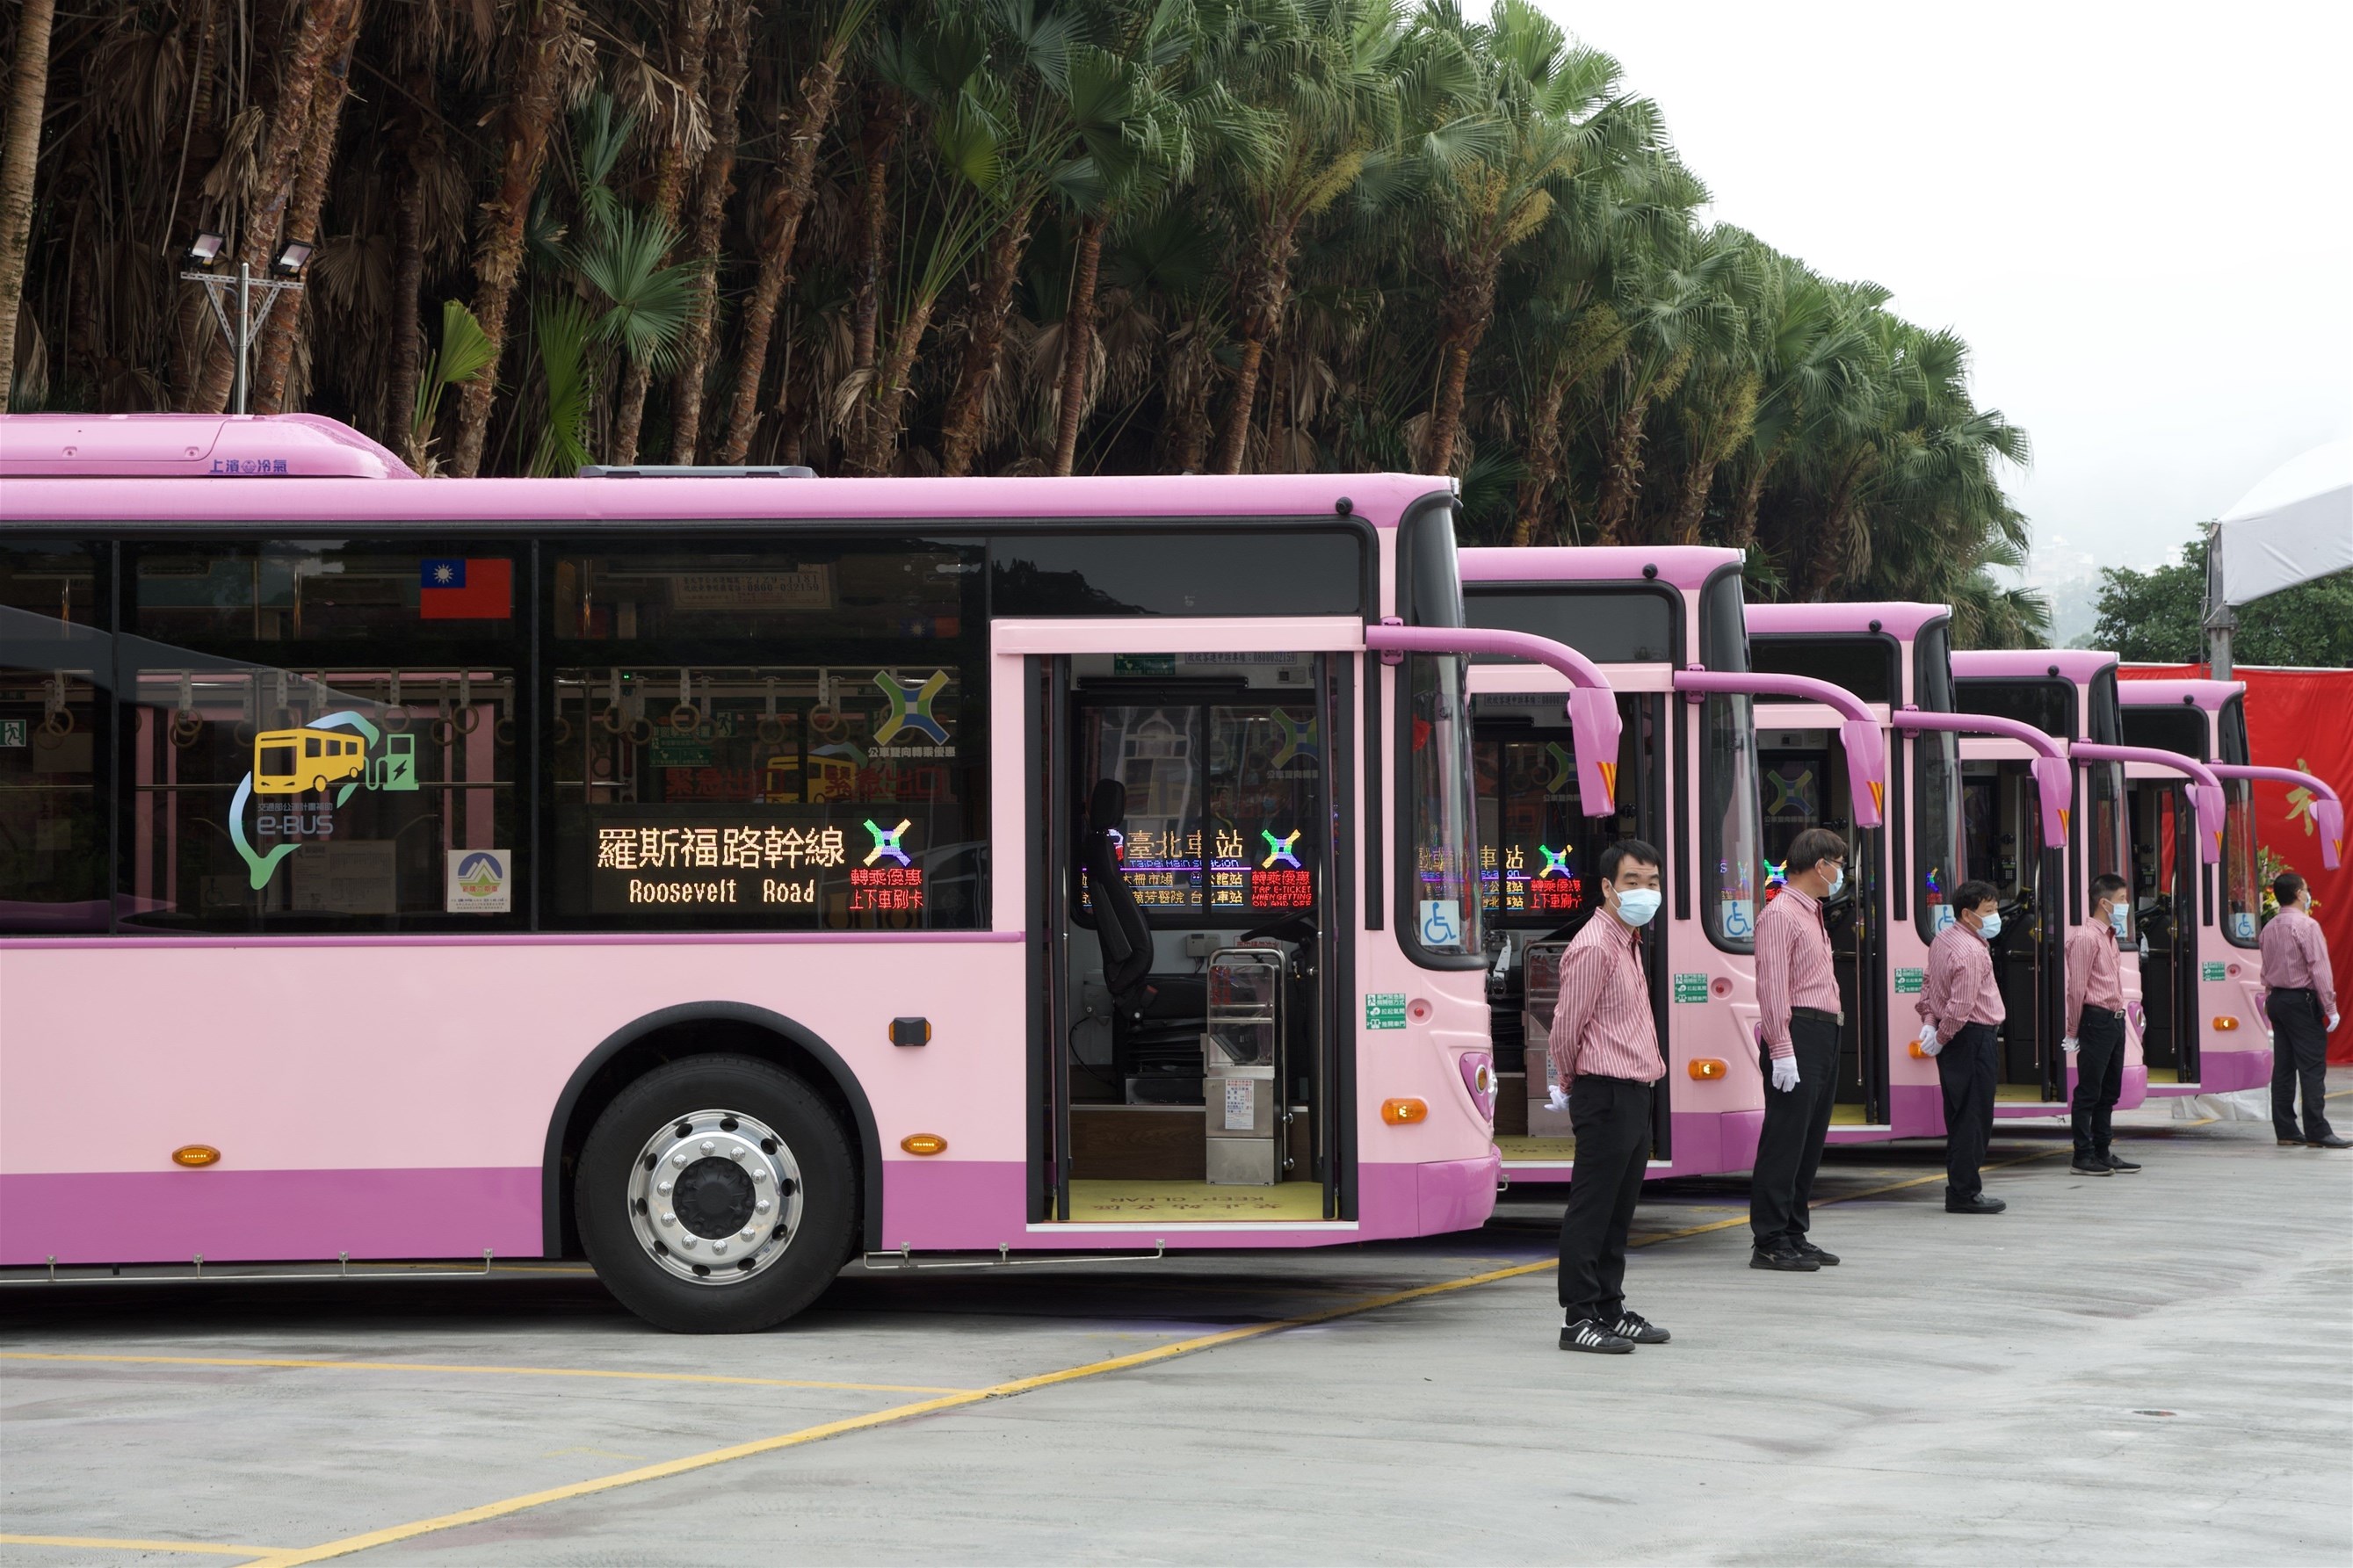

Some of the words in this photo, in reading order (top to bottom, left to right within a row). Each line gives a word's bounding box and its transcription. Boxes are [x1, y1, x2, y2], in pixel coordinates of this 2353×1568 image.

[257, 815, 333, 835] e-BUS
[597, 827, 846, 870] 羅斯福路幹線
[849, 868, 923, 885] 轉乘優惠
[1252, 871, 1310, 885] 轉乘優惠
[628, 878, 737, 904] Roosevelt
[762, 878, 815, 904] Road
[849, 888, 924, 909] 上下車刷卡
